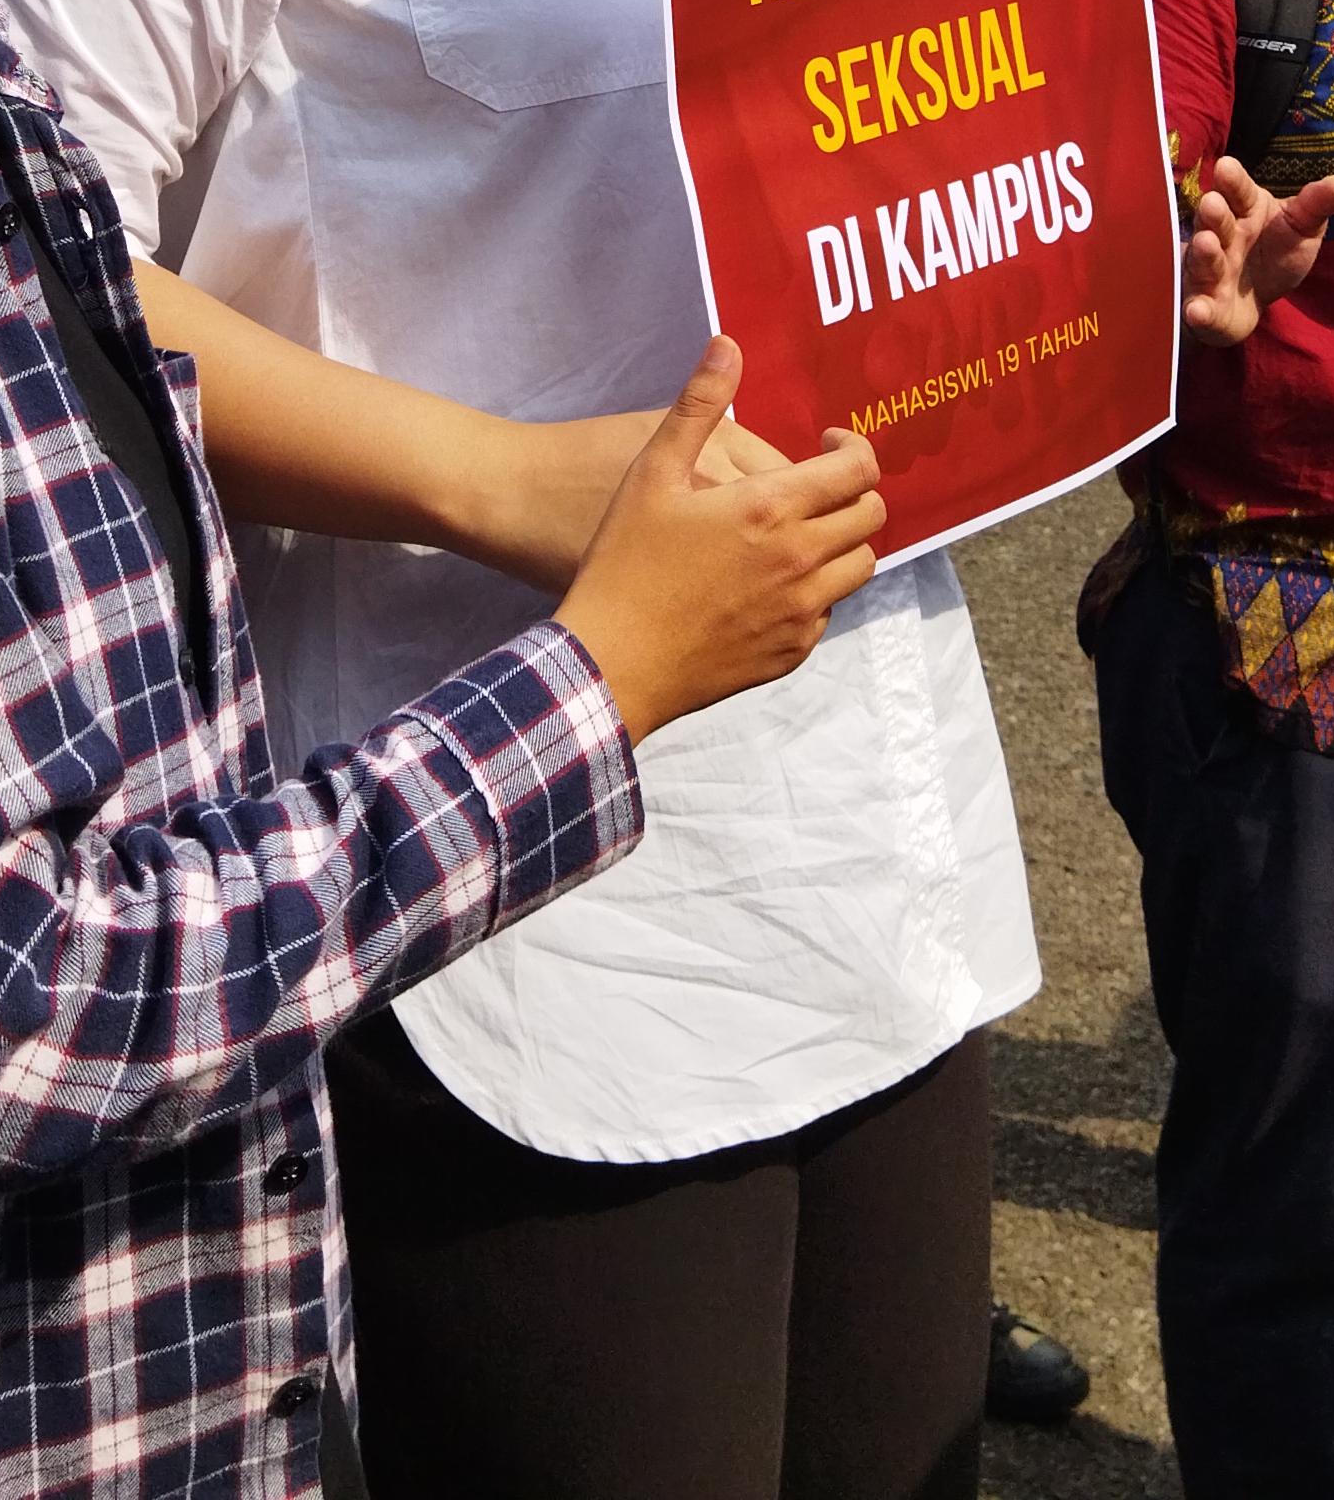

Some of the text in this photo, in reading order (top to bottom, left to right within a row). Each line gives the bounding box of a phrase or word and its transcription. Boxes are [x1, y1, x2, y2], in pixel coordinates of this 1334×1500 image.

[804, 2, 1046, 153] SEKSUAL
[806, 141, 1093, 326] DI KAMPUS
[850, 311, 1100, 438] MAHASISWI, 19 TAHUN
